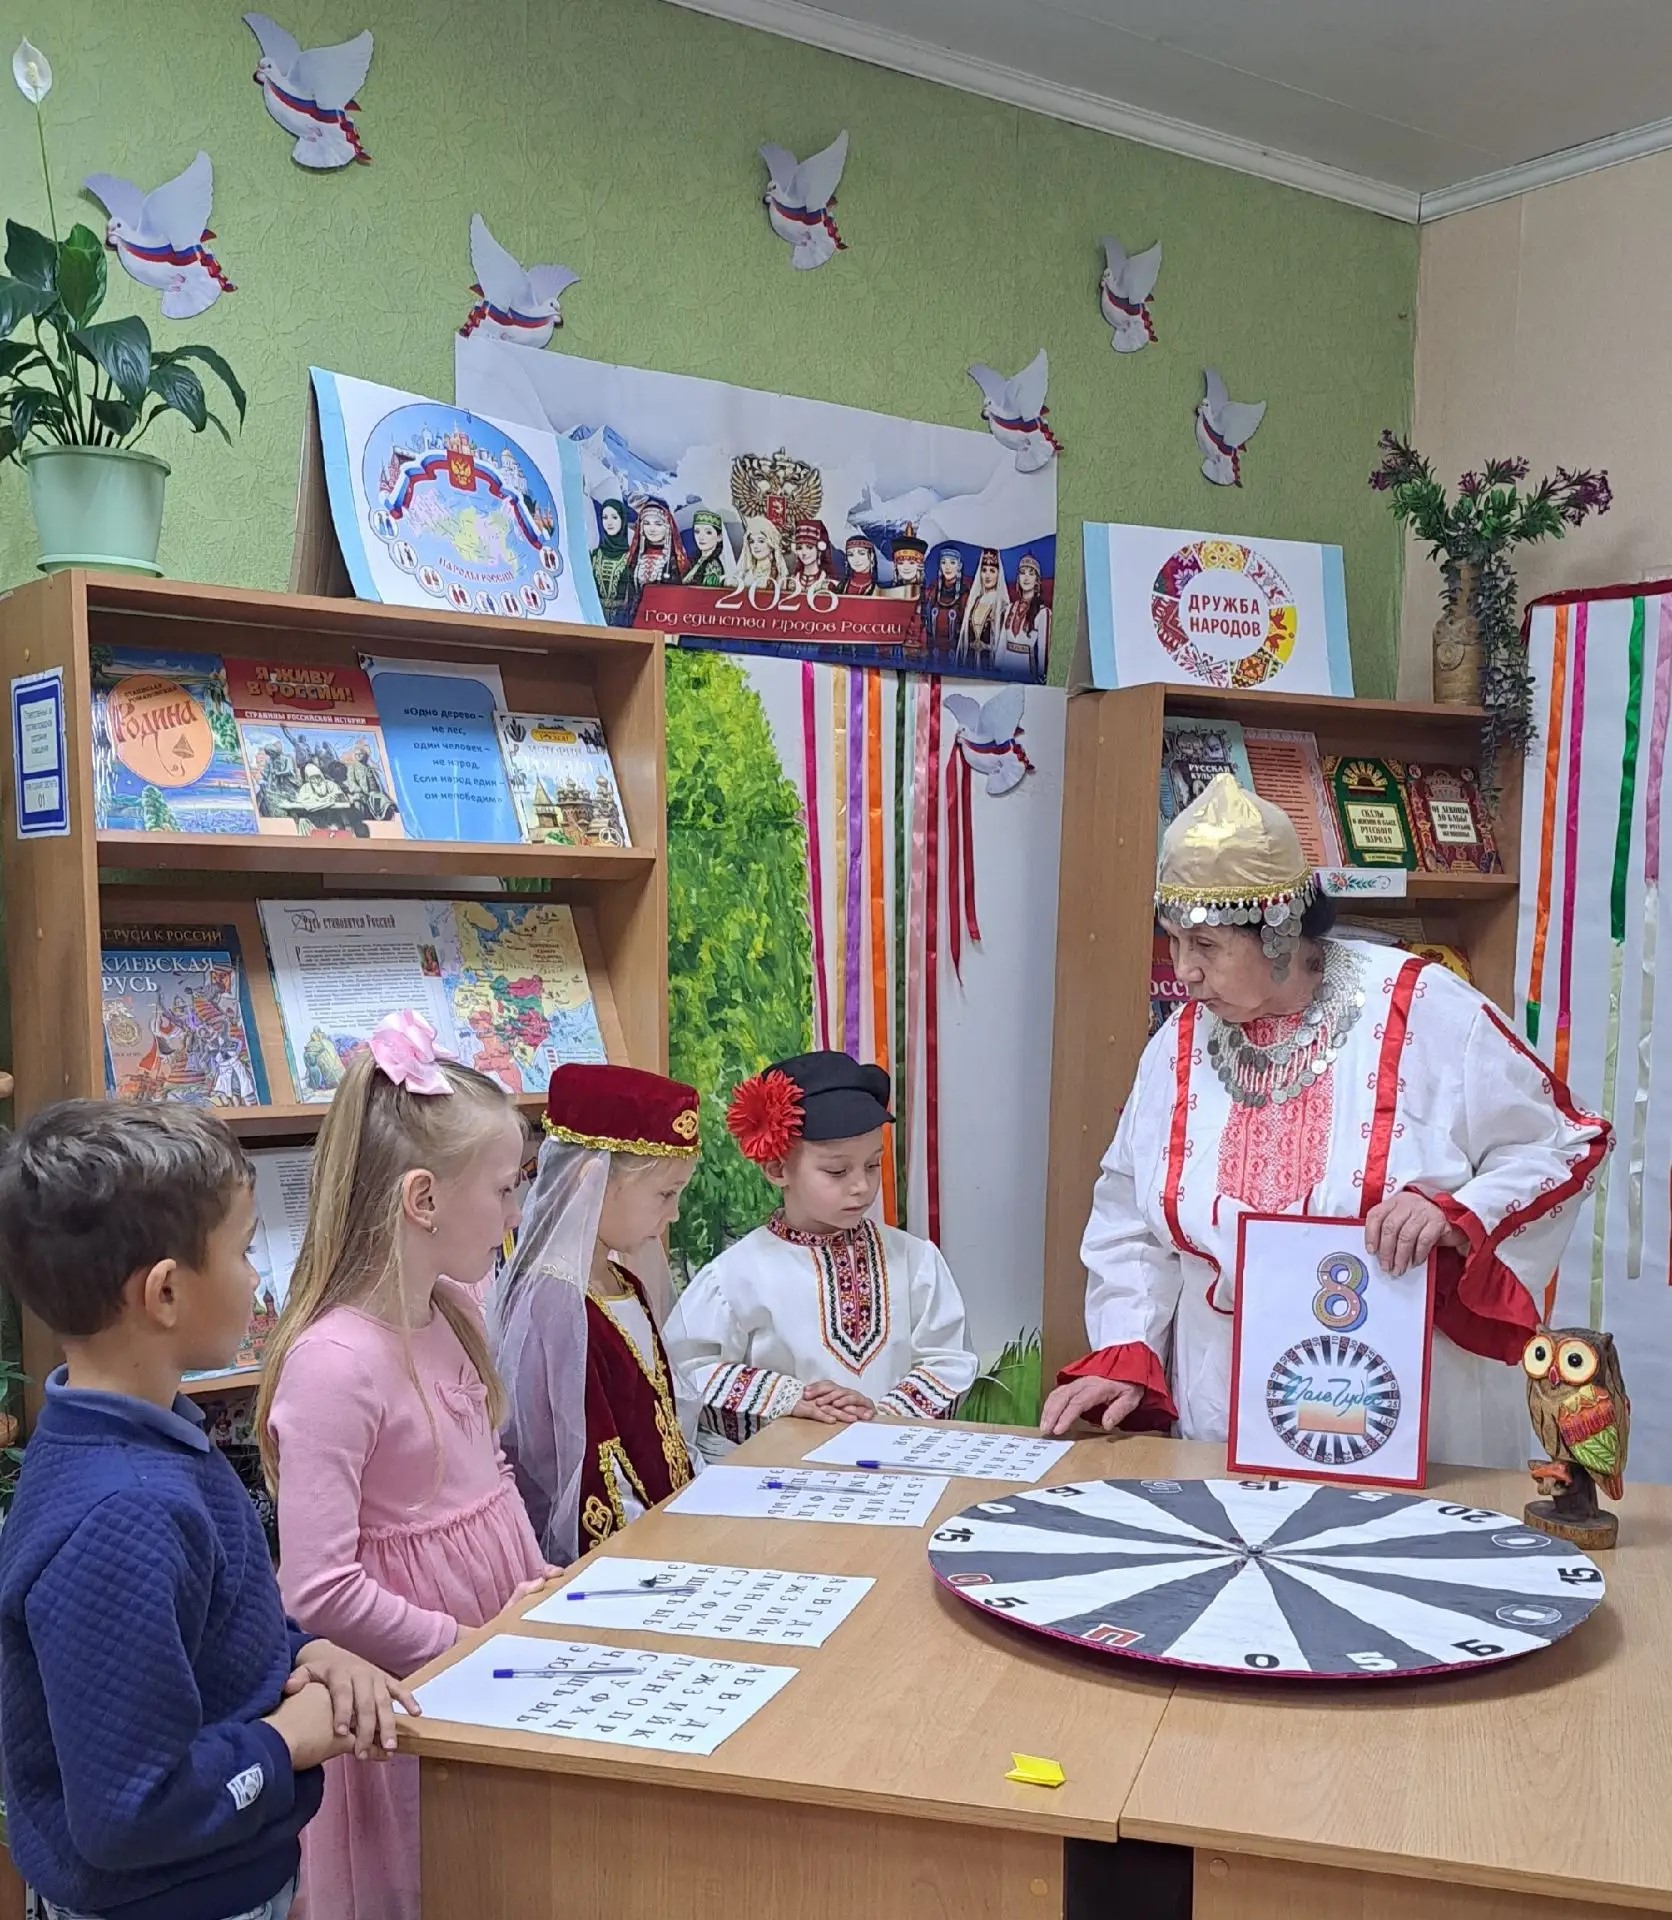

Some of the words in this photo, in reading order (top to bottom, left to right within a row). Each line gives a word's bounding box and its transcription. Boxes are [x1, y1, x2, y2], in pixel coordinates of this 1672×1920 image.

[715, 573, 840, 613] 2026
[1188, 594, 1260, 615] ДРУЖБА
[644, 609, 679, 625] Год
[683, 613, 766, 629] единства
[840, 620, 901, 634] России
[1190, 616, 1261, 638] НАРОДОВ
[255, 666, 269, 680] Я
[275, 667, 335, 685] ЖИВУ
[246, 681, 260, 696] В
[265, 682, 354, 703] РОССИИ!
[244, 711, 285, 720] СТРАНИЦЫ
[286, 713, 333, 723] РОССИЙСКОЙ
[334, 717, 366, 725] ИСТОРИИ
[404, 707, 438, 717] «Одно
[440, 710, 476, 719] дерево
[447, 727, 467, 736] лес,
[413, 742, 440, 751] один
[442, 743, 482, 752] человек
[1188, 763, 1230, 773] РУССКАЯ
[413, 774, 438, 783] Если
[440, 775, 472, 785] народ
[473, 779, 497, 787] един
[114, 927, 150, 941] РУСИ
[154, 930, 163, 941] К
[166, 929, 223, 942] РОССИИ
[101, 956, 214, 972] КИЕВСКАЯ
[102, 976, 157, 995] РУСЬ
[1312, 1251, 1369, 1333] 8
[1238, 1480, 1288, 1491] 15
[1437, 1505, 1501, 1524] 20
[933, 1527, 976, 1544] 15
[1556, 1567, 1603, 1585] 15
[984, 1596, 1029, 1609] 5
[637, 1653, 659, 1663] С
[1244, 1653, 1280, 1669] 0
[655, 1669, 684, 1682] М
[691, 1673, 719, 1686] Ж
[641, 1682, 668, 1694] Н
[588, 1693, 611, 1703] Ф
[627, 1697, 649, 1707] О
[569, 1705, 597, 1715] Х
[593, 1723, 618, 1733] Р
[628, 1728, 656, 1740] К
[669, 1732, 696, 1743] Е
